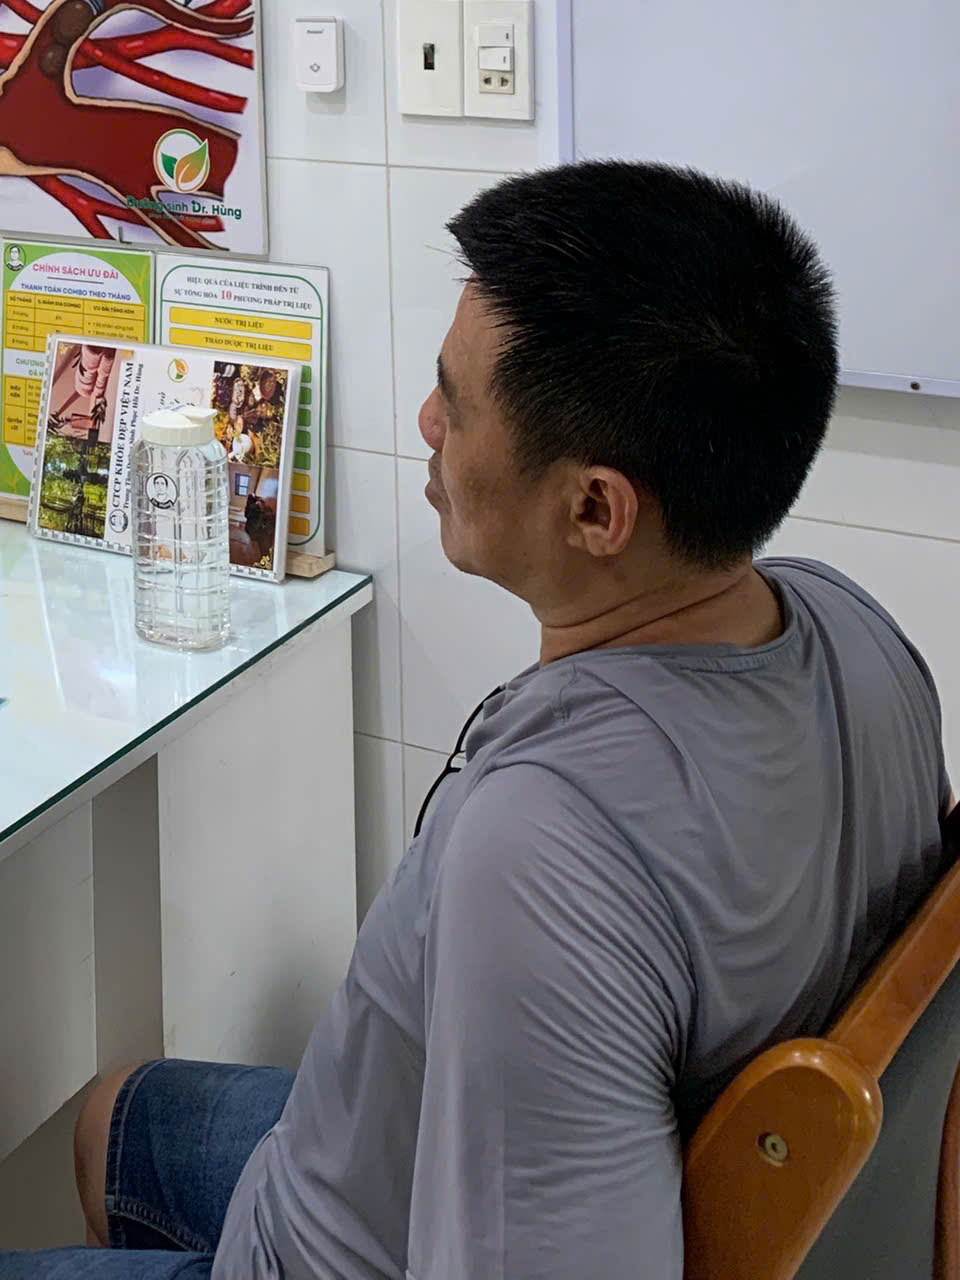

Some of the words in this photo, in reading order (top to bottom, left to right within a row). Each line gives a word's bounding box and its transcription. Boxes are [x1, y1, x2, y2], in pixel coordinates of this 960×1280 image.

[167, 201, 189, 212] sinh
[191, 200, 208, 213] Dr.
[212, 203, 242, 220] Hùng
[32, 263, 59, 274] CHÍNH
[61, 265, 85, 276] SÁCH
[62, 288, 87, 296] COMBO
[220, 290, 233, 300] 10
[124, 362, 133, 387] NAM
[120, 390, 131, 415] VIỆT
[118, 418, 128, 440] ĐẸP
[115, 443, 124, 475] KHỎE
[112, 478, 121, 507] CTCP
